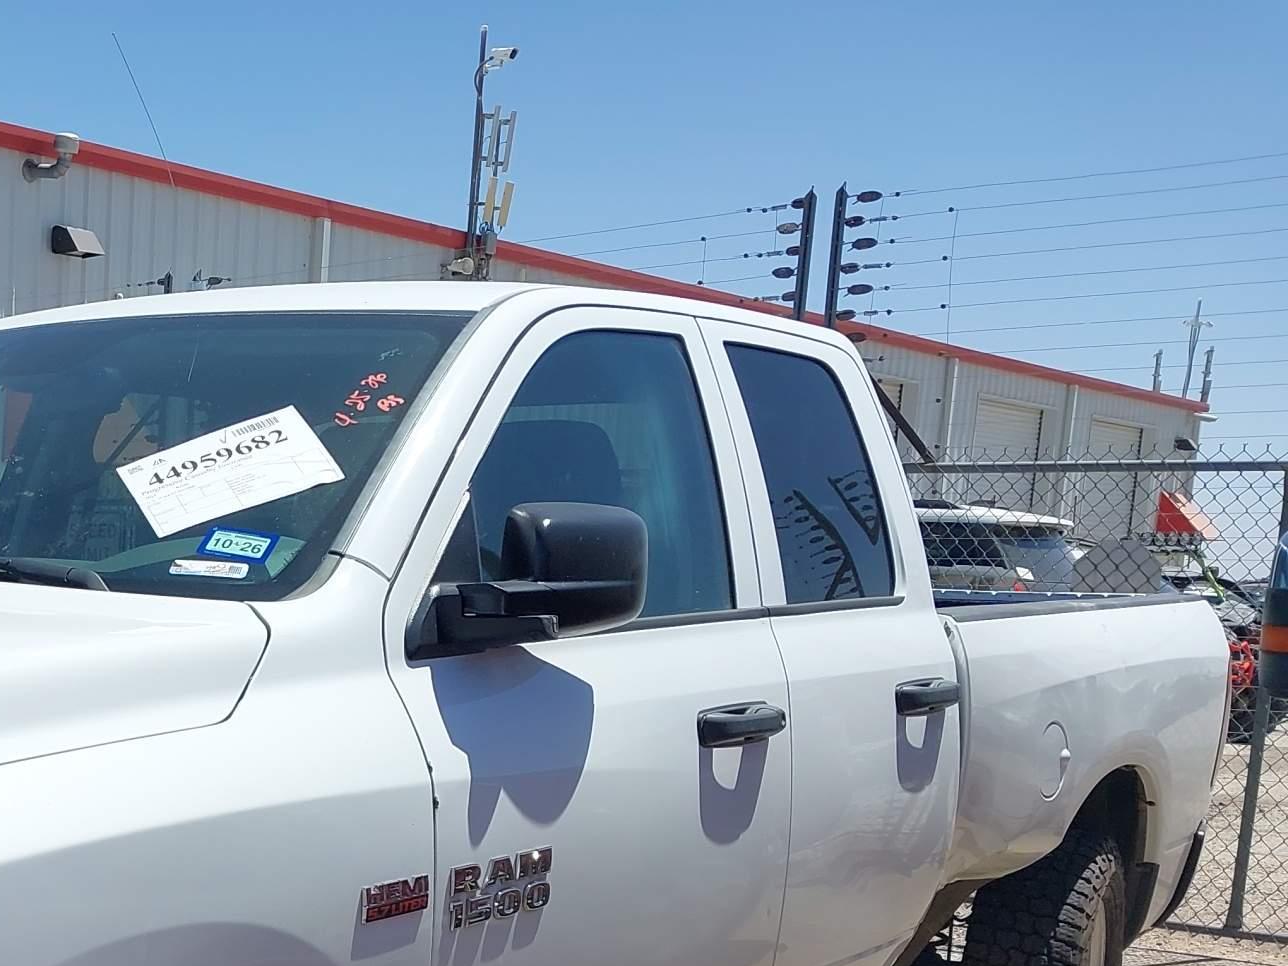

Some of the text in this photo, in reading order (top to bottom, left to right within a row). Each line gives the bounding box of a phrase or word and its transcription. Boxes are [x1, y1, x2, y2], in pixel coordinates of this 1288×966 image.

[148, 429, 289, 486] 44959682
[449, 845, 553, 897] RAM
[449, 881, 552, 931] 1500
